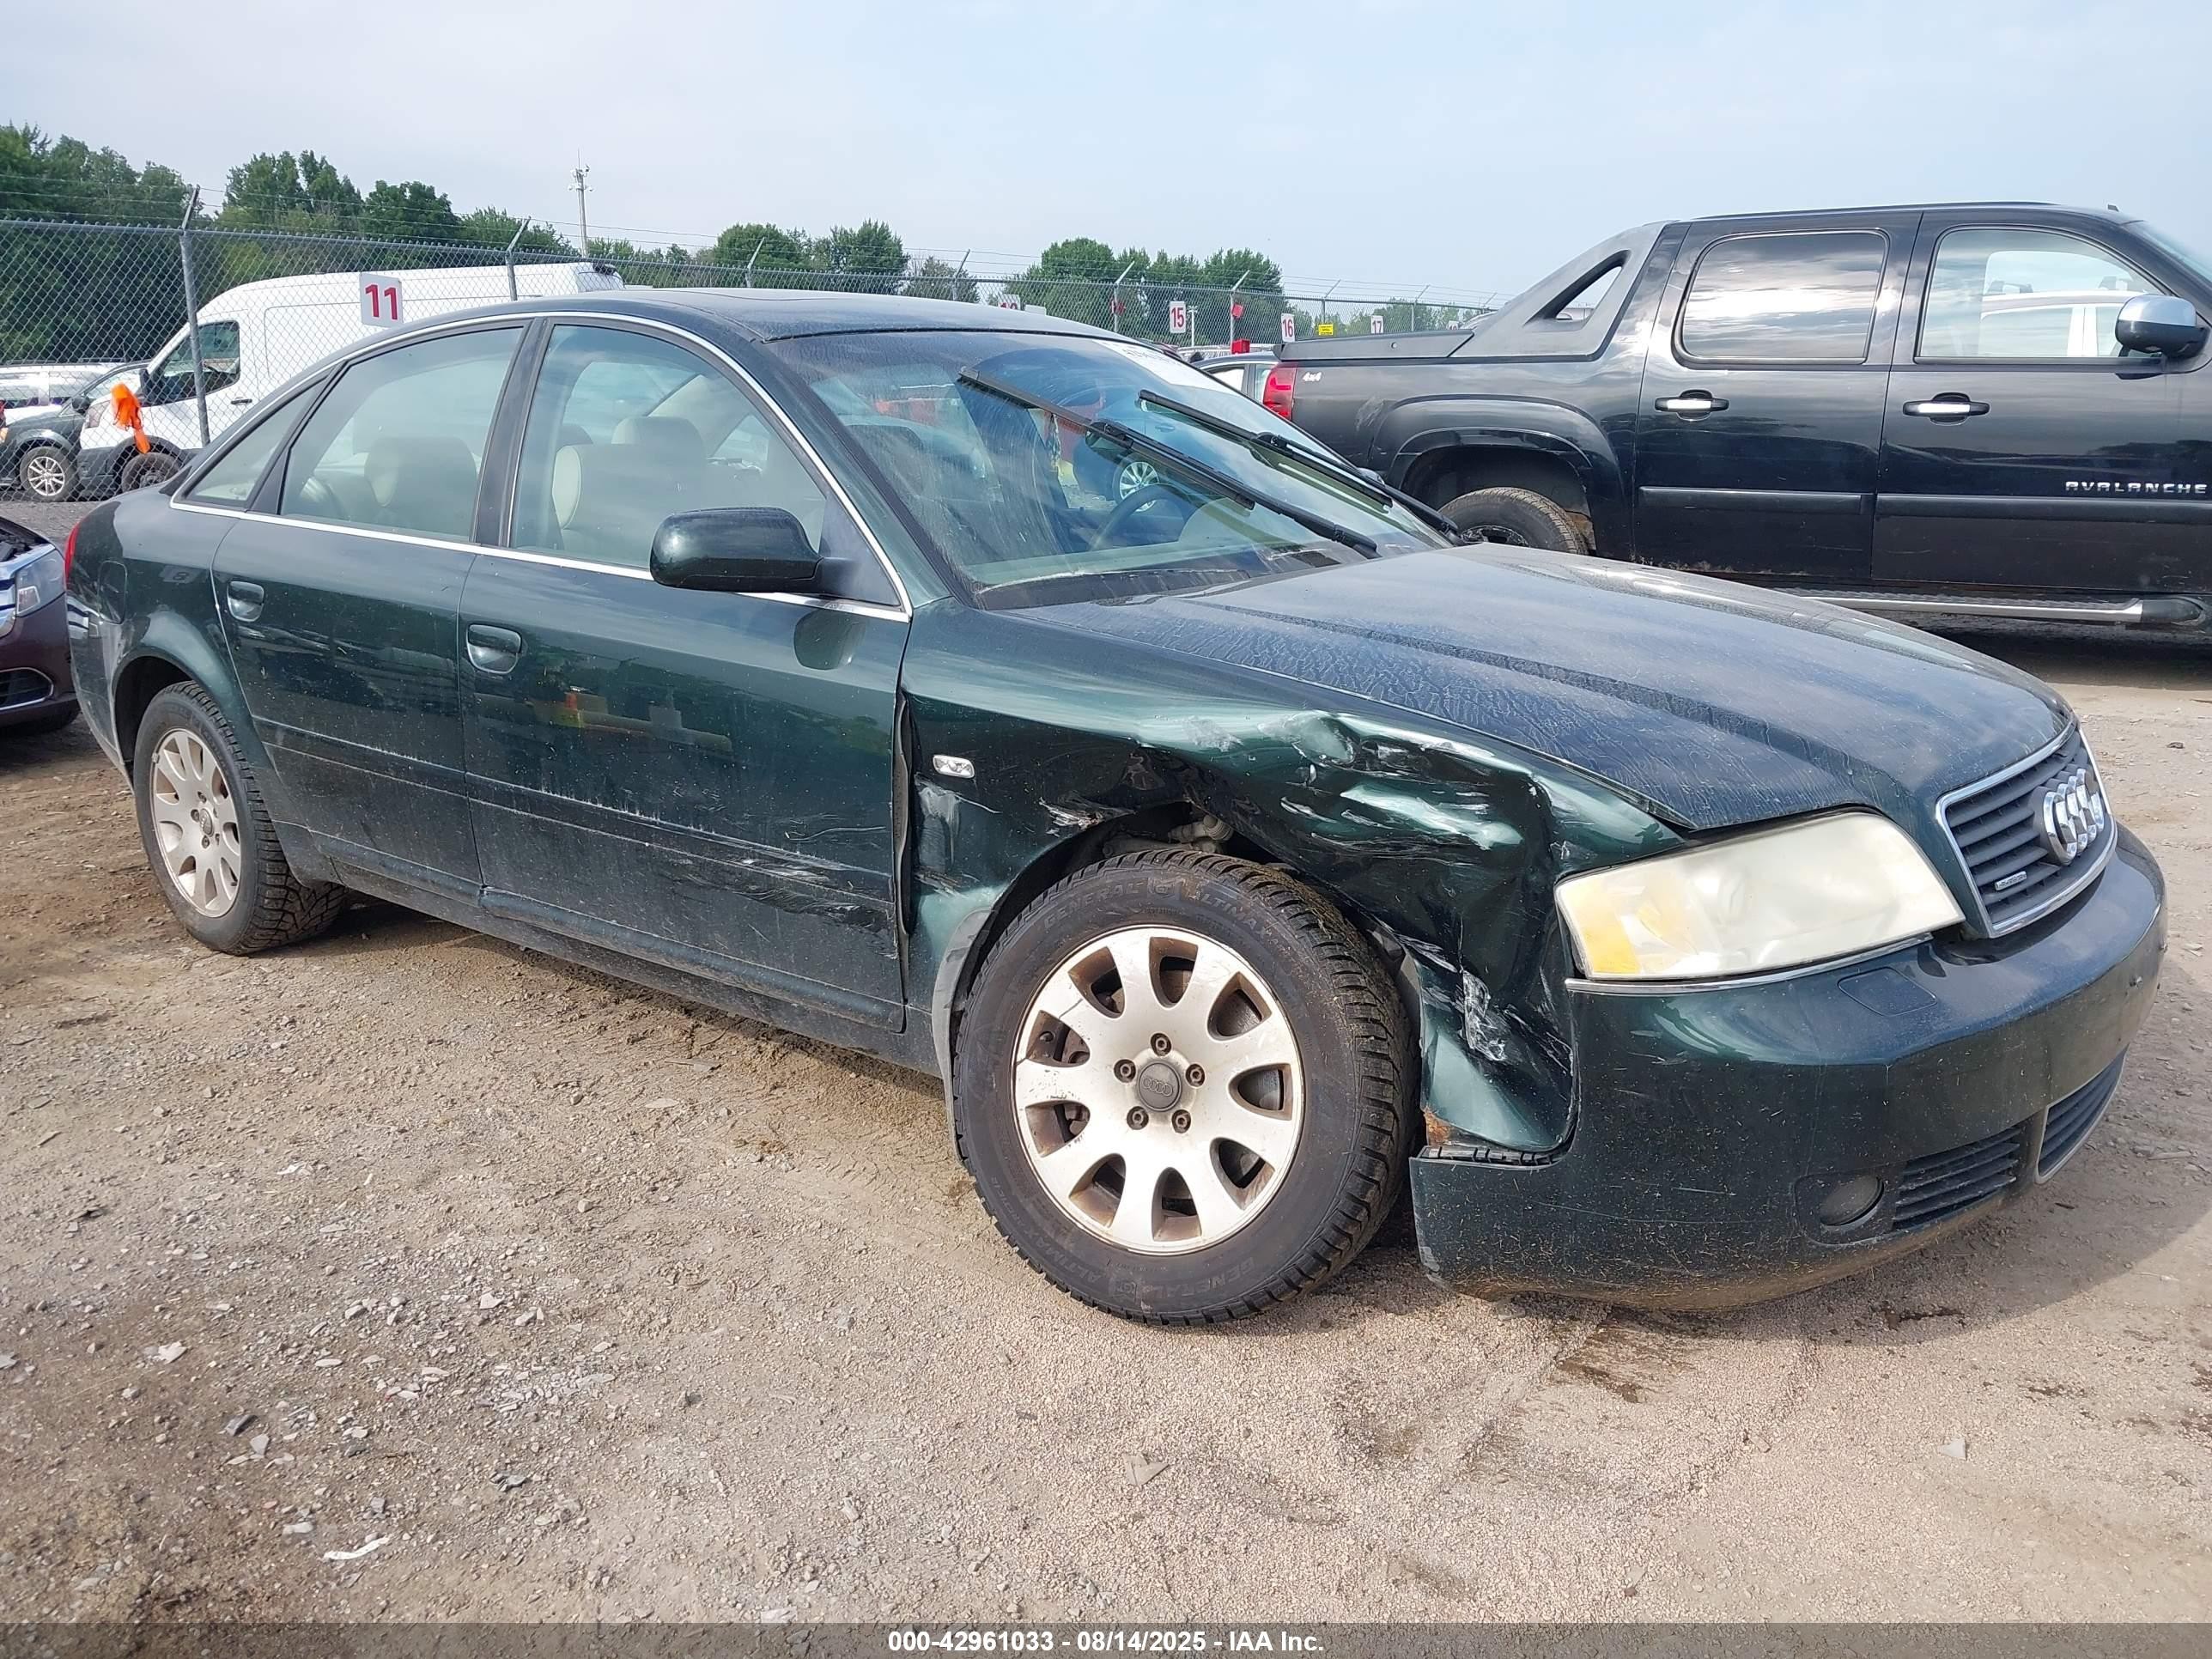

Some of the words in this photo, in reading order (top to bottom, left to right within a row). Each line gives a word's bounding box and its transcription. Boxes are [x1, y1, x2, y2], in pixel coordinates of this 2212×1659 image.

[365, 284, 398, 319] 11
[1171, 307, 1184, 327] 15
[1282, 319, 1293, 337] 16
[1372, 320, 1382, 333] 17
[2065, 481, 2208, 494] AVALANCHE
